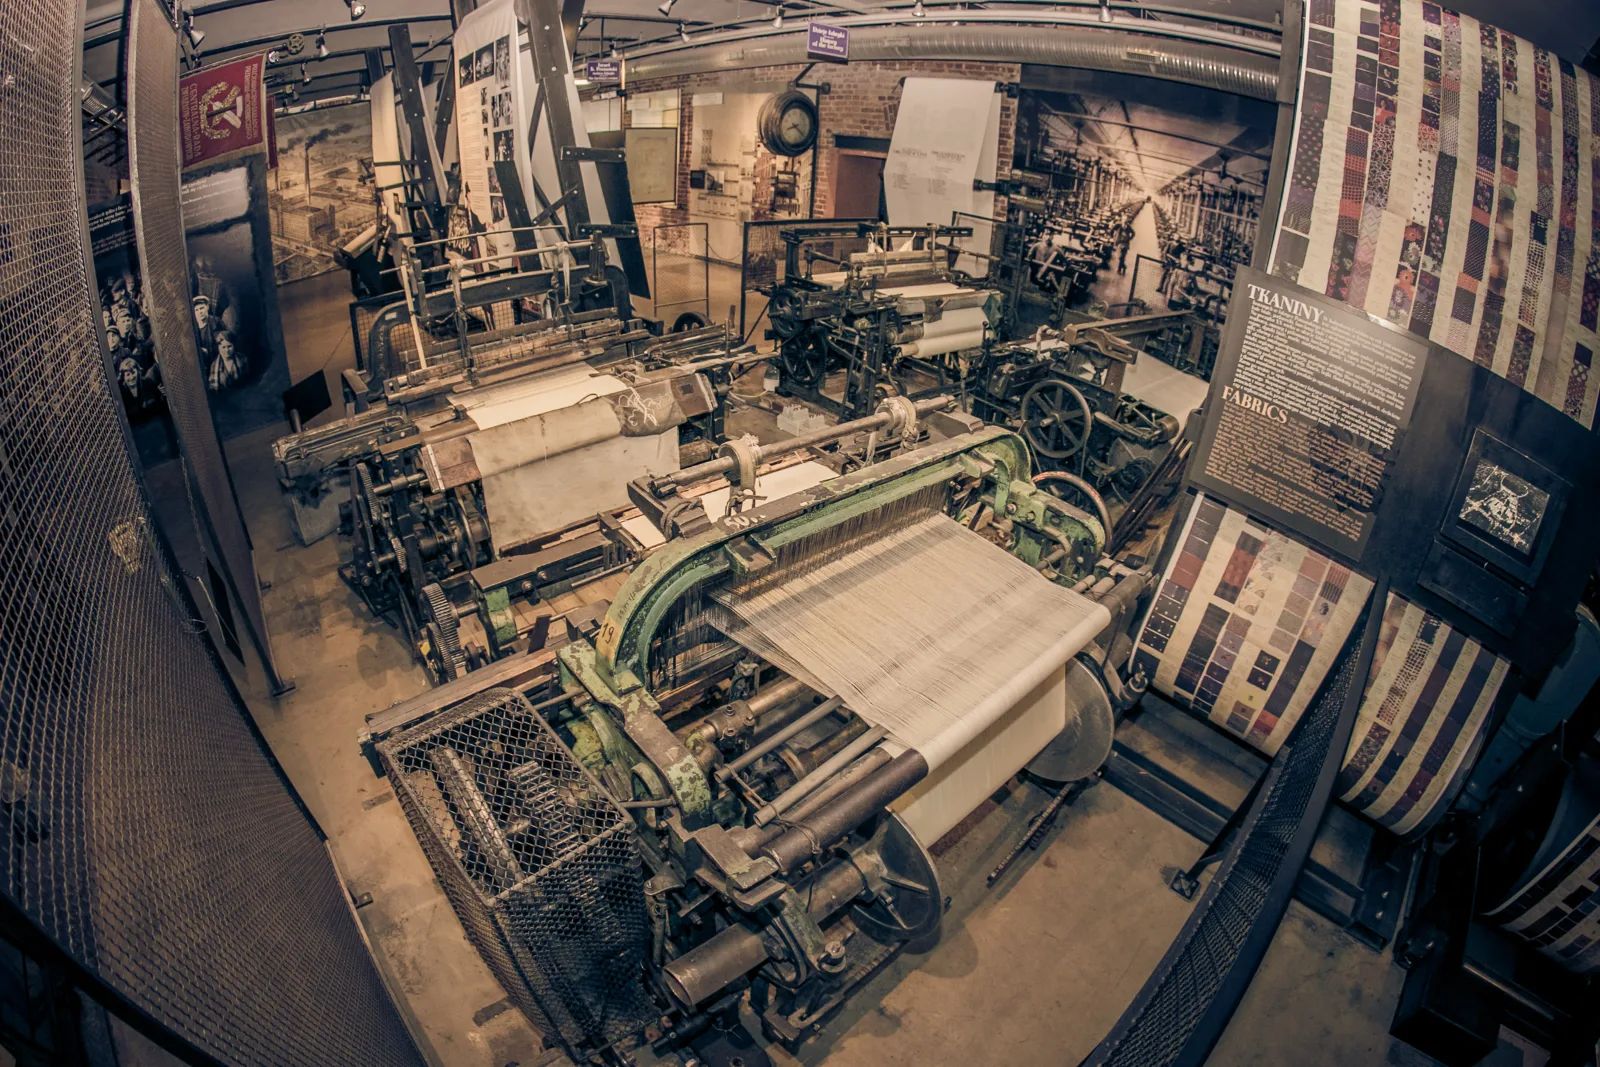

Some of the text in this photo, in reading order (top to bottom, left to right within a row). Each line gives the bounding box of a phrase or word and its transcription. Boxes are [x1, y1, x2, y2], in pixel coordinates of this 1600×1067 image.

[1247, 284, 1324, 323] TKANINY
[1222, 385, 1289, 424] FABRICS
[602, 622, 615, 644] 19
